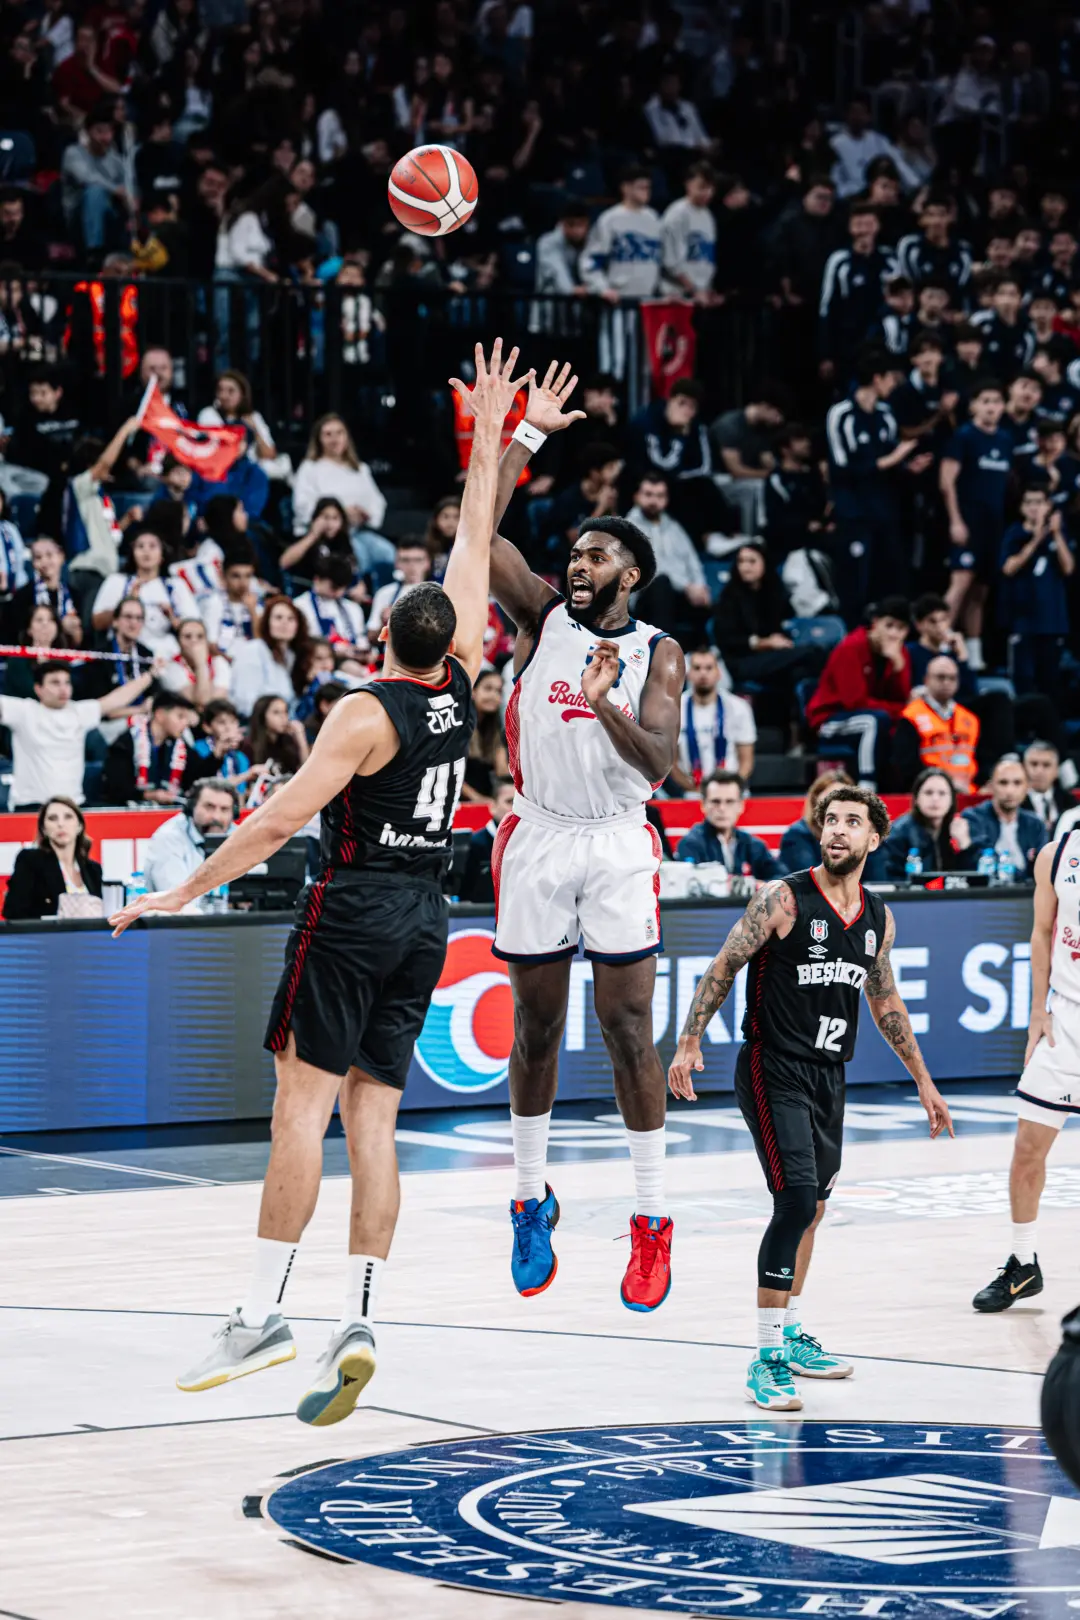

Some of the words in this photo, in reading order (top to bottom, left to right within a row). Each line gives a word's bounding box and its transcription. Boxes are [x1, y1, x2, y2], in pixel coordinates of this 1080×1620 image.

[412, 756, 466, 832] 41
[814, 1014, 848, 1052] 12
[337, 1429, 1046, 1490] UNIVERSIT
[304, 1499, 1080, 1618] AHÇEŞEHİR
